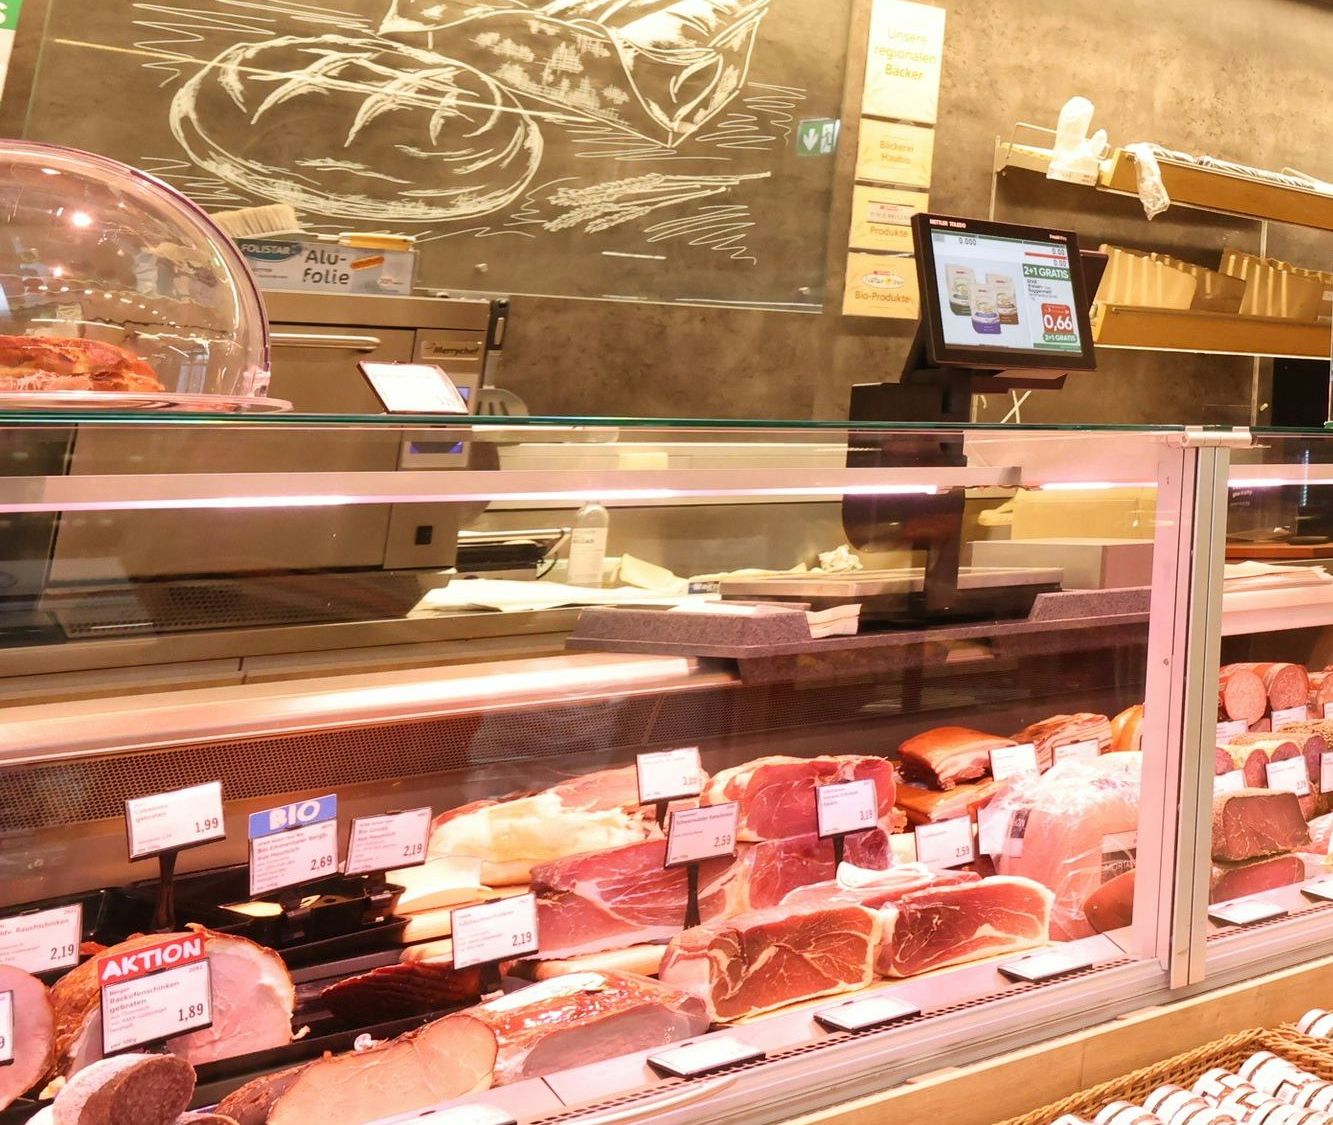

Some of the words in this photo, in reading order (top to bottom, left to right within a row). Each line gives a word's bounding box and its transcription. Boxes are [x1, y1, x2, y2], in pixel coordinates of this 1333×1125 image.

[887, 27, 929, 45] Unsere
[874, 44, 936, 65] regionalen
[870, 226, 908, 238] Produkte
[240, 243, 291, 255] FOLISTAR
[304, 249, 347, 266] Alu-
[302, 267, 350, 285] folie
[1023, 265, 1039, 276] 2+1
[1039, 266, 1069, 279] GRATIS
[855, 291, 912, 304] Bio-Produkte
[1043, 314, 1073, 333] 0,66
[433, 346, 480, 356] Merrychef
[269, 800, 320, 830] BIO
[195, 817, 219, 833] 1,99
[403, 843, 423, 857] 2,19
[310, 855, 333, 871] 2,69
[512, 931, 532, 947] 2,19
[50, 943, 75, 961] 2,19
[101, 937, 201, 981] AKTION
[178, 1003, 204, 1022] 1,89
